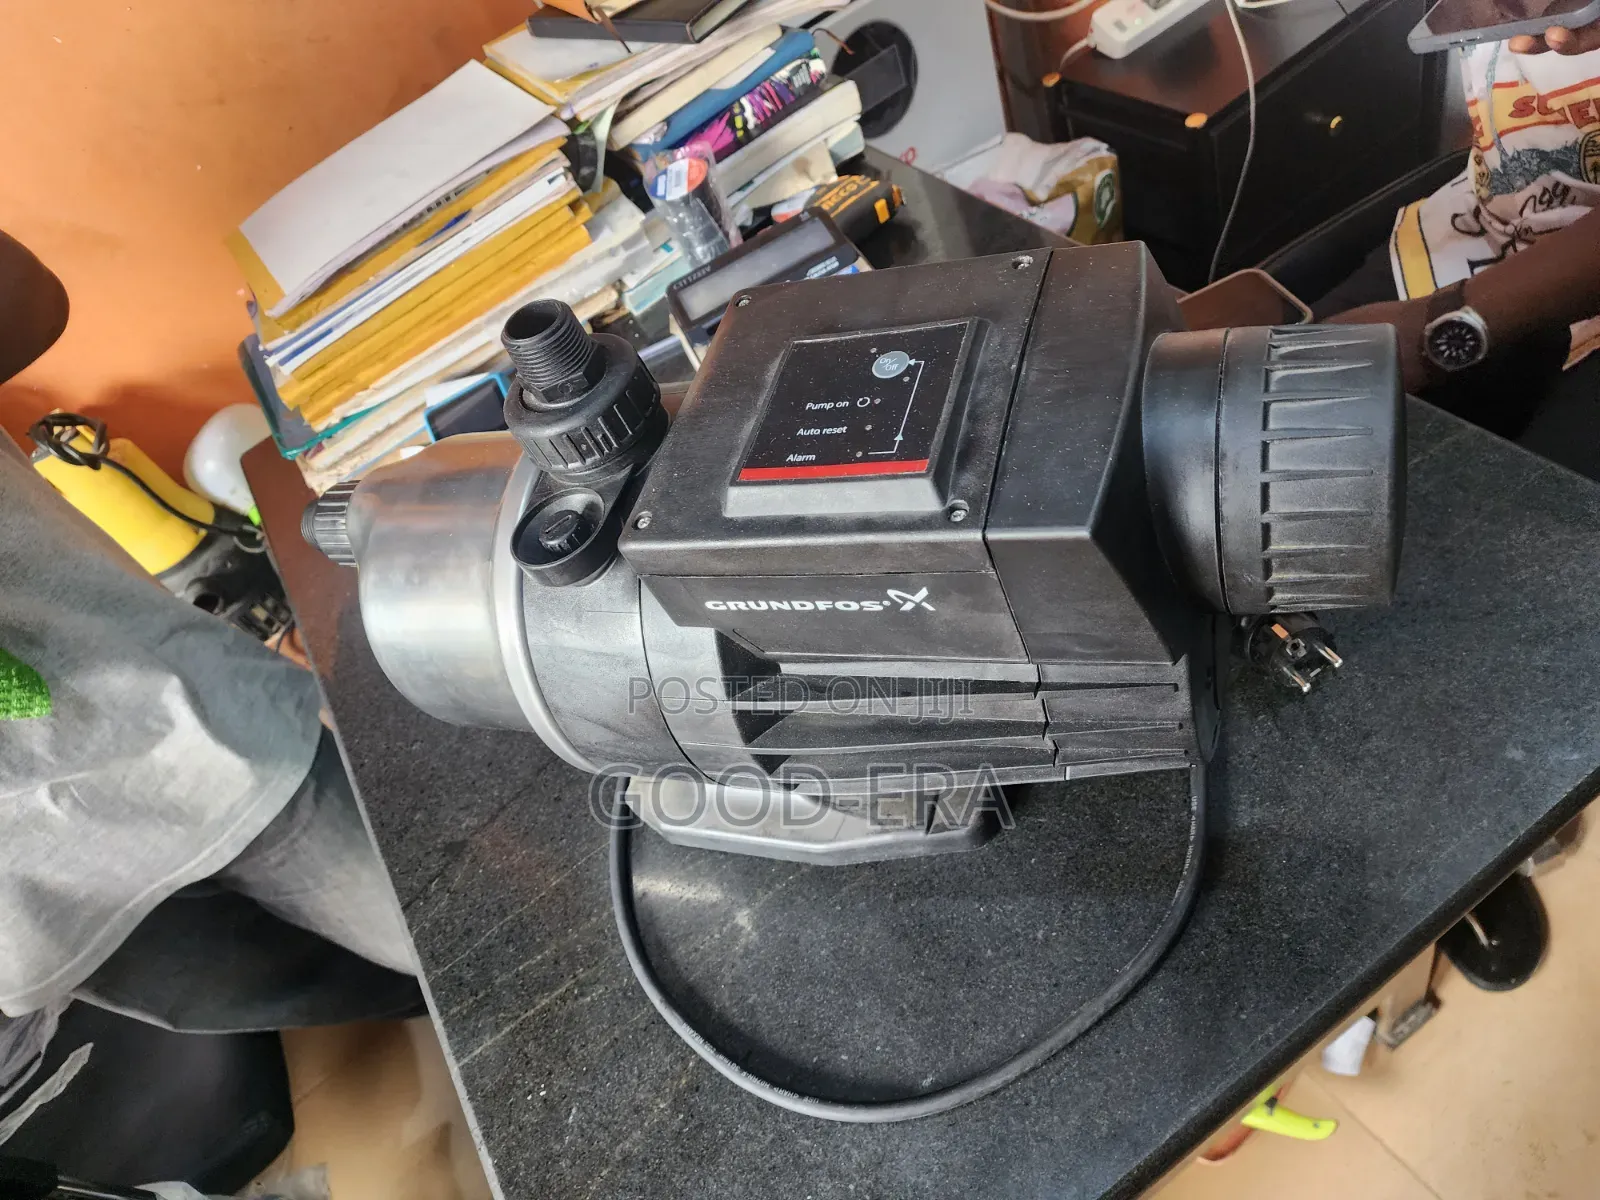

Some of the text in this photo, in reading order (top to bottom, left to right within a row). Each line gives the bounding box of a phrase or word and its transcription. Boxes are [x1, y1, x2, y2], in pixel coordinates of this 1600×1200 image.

[805, 400, 849, 411] Pump on
[797, 426, 848, 436] Auto reset
[786, 453, 816, 462] Alarm
